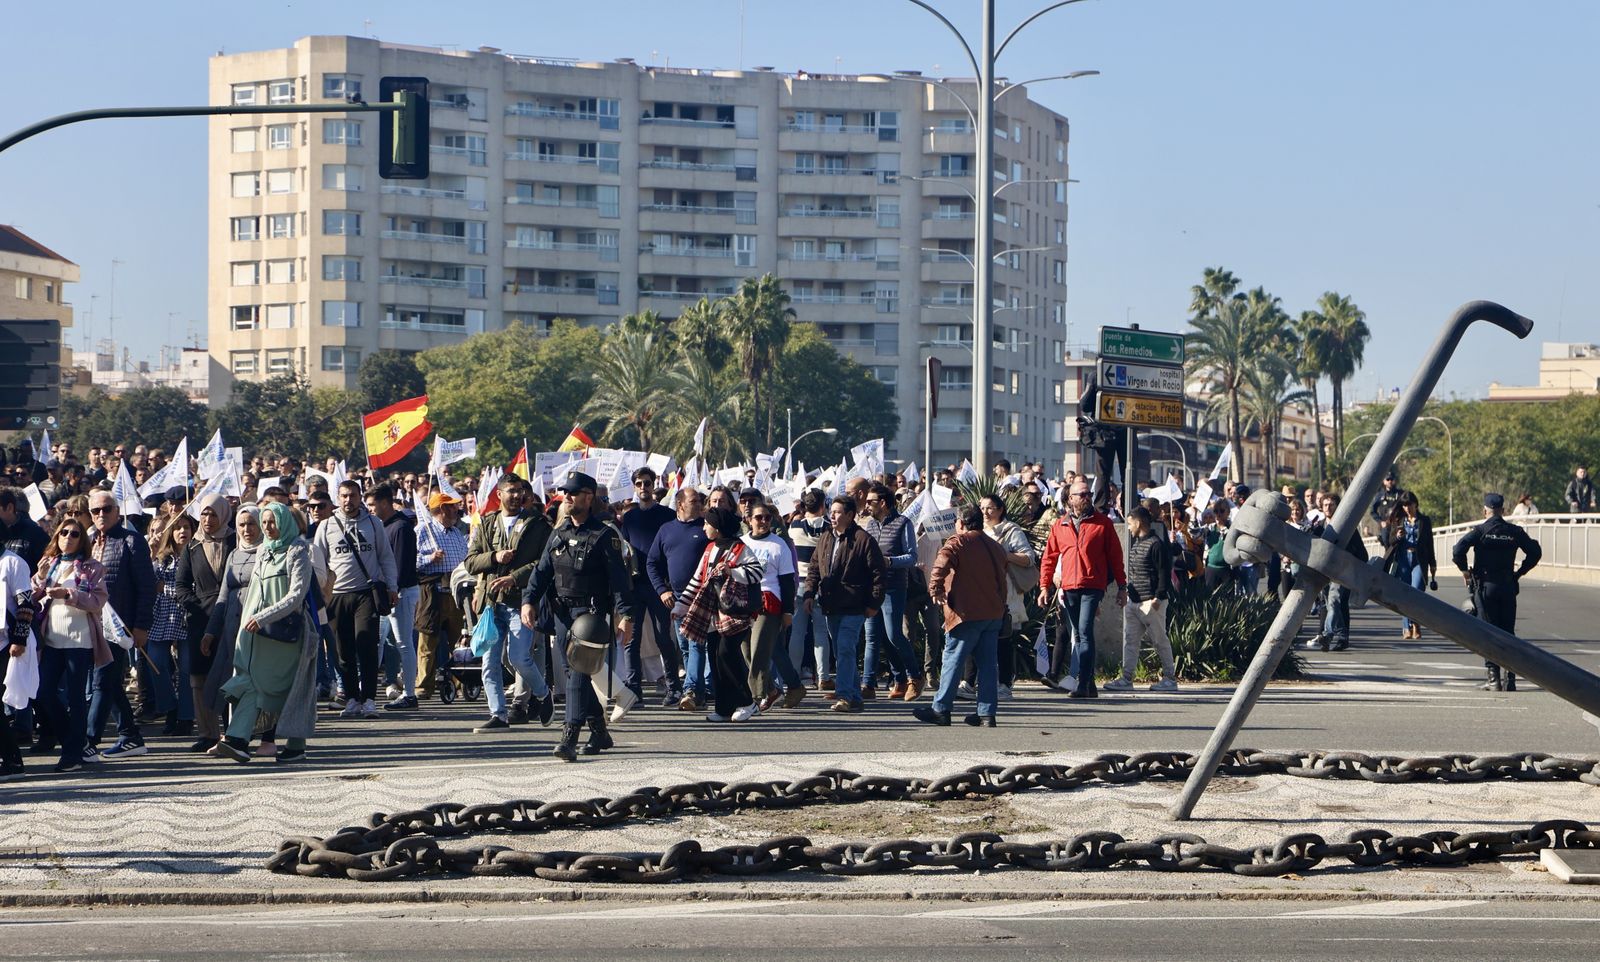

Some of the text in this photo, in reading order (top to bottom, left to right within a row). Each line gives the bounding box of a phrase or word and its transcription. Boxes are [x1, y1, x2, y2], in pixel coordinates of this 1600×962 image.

[1104, 333, 1131, 342] puente de
[1104, 342, 1153, 357] Los Remedios
[1160, 369, 1180, 379] hospital
[1127, 375, 1148, 388] Virgen
[1150, 378, 1160, 389] del
[1160, 402, 1180, 413] Prado
[1131, 410, 1145, 421] San
[942, 512, 957, 521] AGUA
